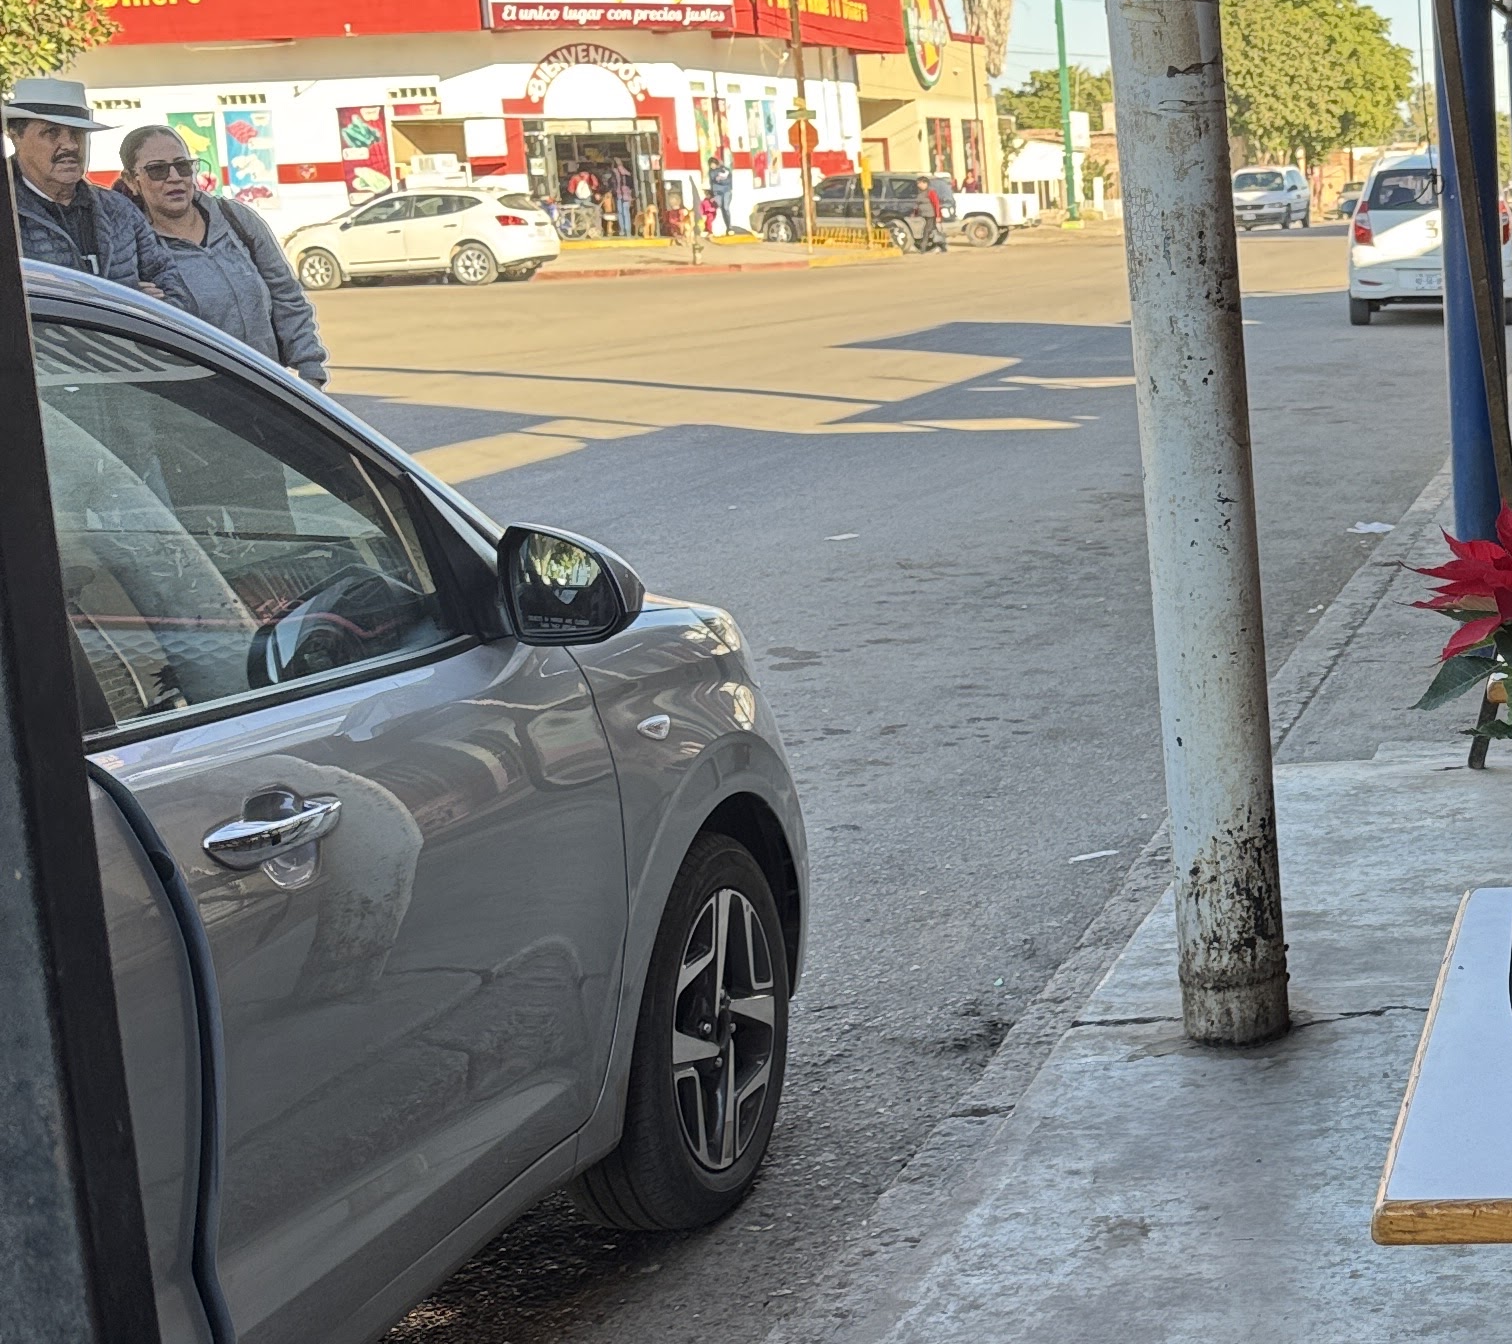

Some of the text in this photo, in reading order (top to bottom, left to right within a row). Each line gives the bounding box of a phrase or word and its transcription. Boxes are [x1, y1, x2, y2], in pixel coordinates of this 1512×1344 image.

[501, 4, 726, 27] El unico lugar con precios justos
